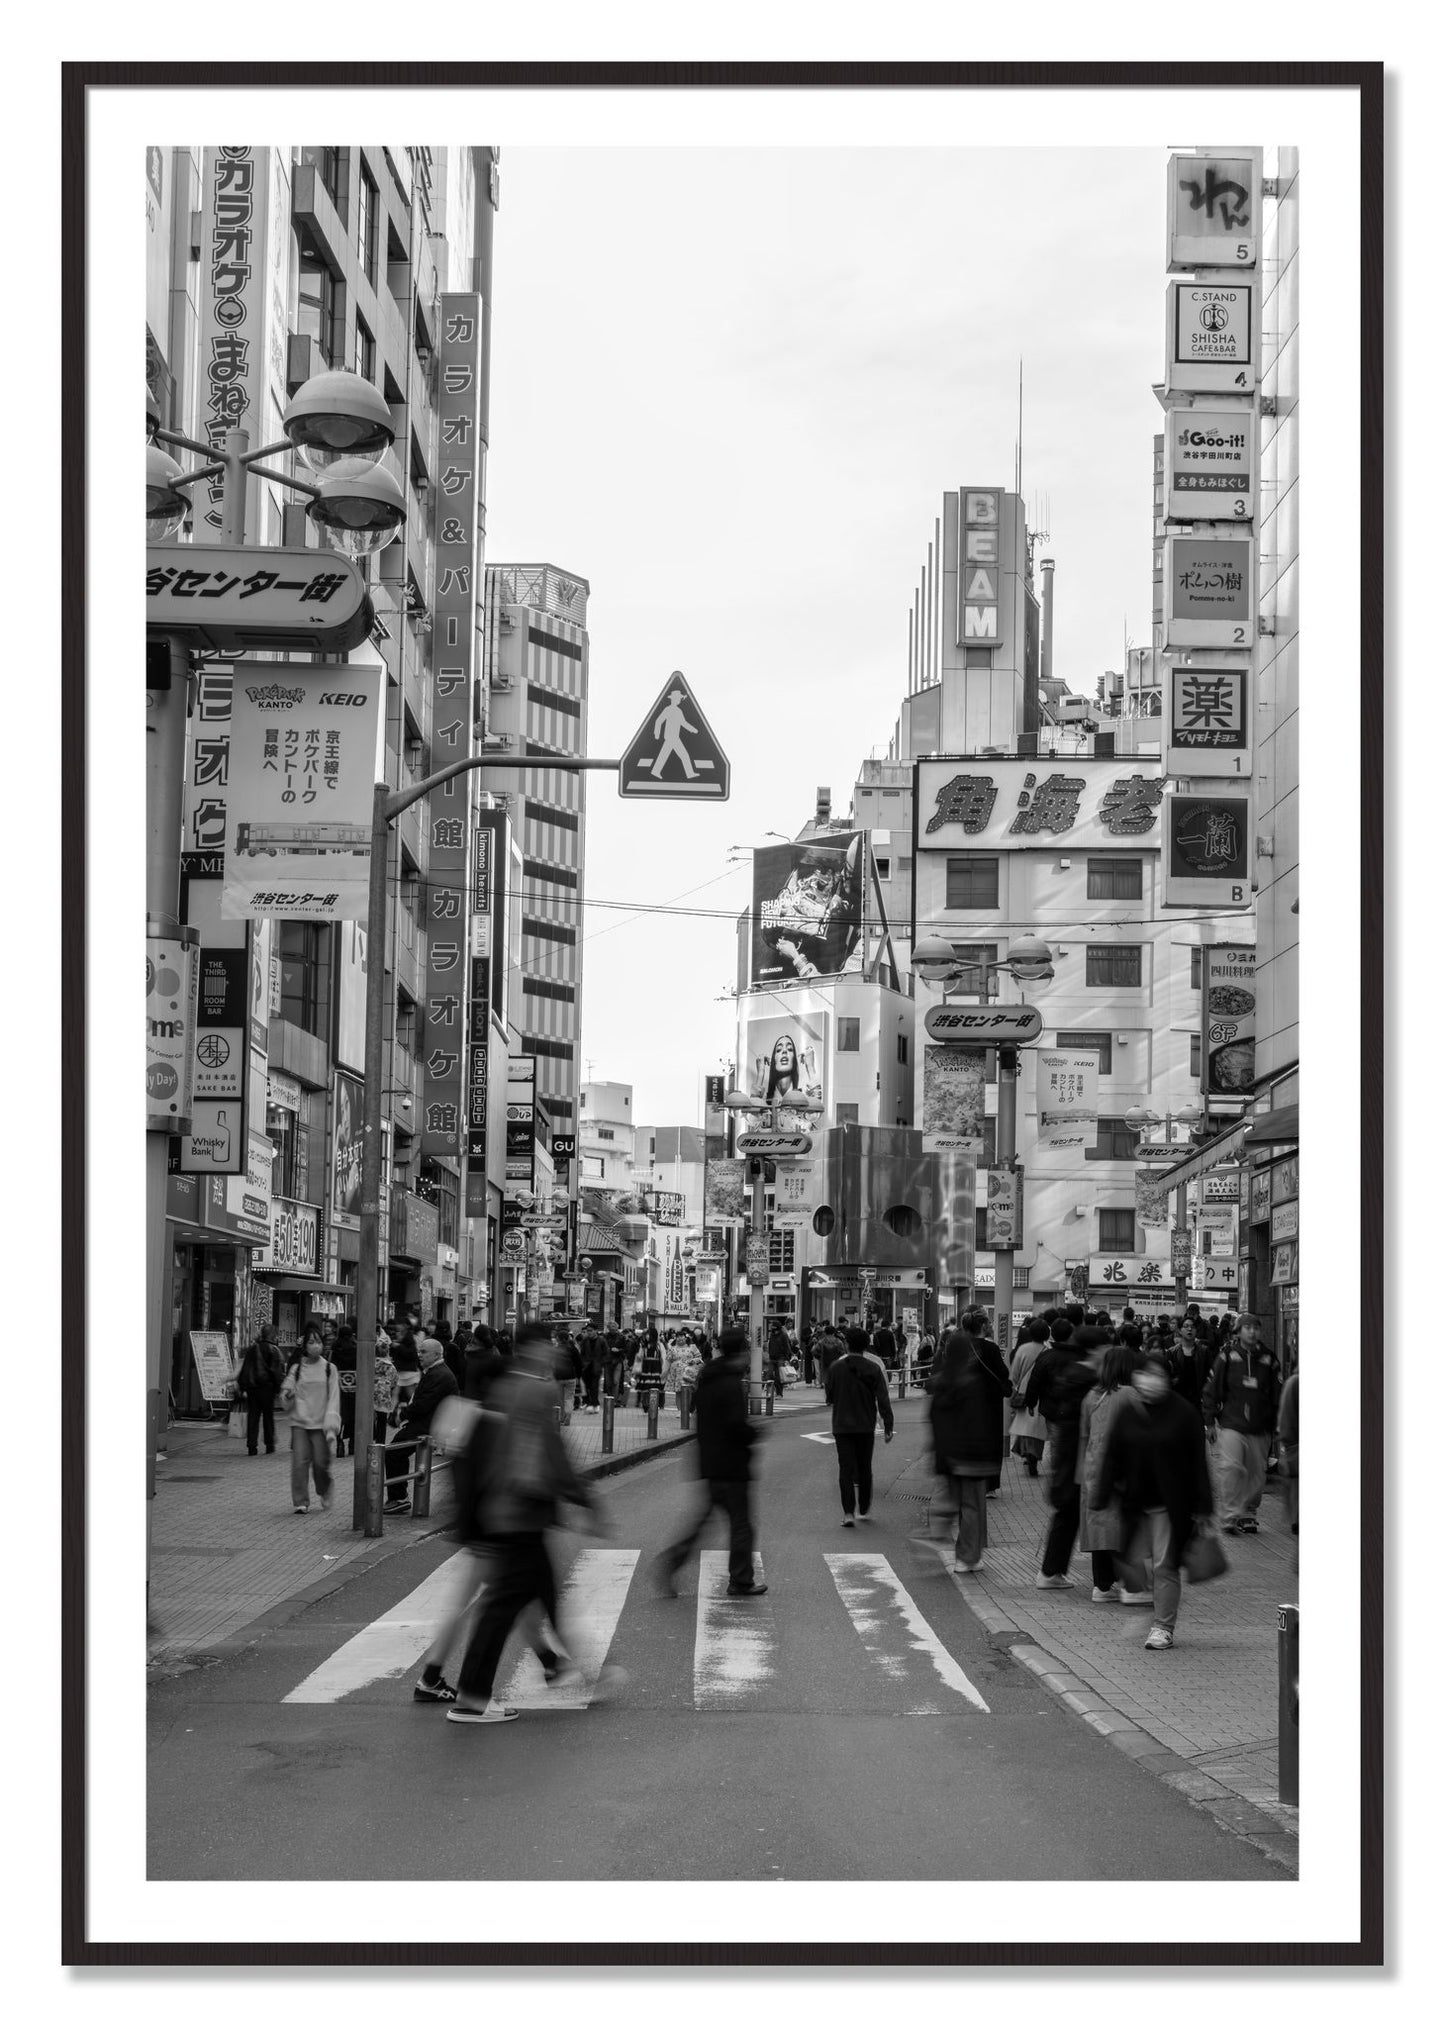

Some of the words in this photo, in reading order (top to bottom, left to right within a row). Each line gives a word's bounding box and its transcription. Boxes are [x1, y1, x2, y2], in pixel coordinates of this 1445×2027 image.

[212, 159, 254, 299] カラオケ
[1236, 244, 1249, 260] 5
[1191, 292, 1237, 302] C.STAND
[1191, 333, 1236, 344] SHISHA
[1191, 344, 1236, 353] CAFE&BAR
[1234, 371, 1247, 387] 4
[1190, 431, 1245, 447] Goo-it!
[1183, 451, 1241, 460] 渋谷宇田川町店
[1178, 476, 1246, 488] 全身もみほぐし
[1234, 499, 1246, 516] 3
[965, 493, 998, 638] BEAM
[1179, 571, 1244, 590] ポムの樹
[1233, 627, 1245, 643] 2
[258, 701, 293, 709] KANTO
[319, 693, 367, 707] KEIO
[1182, 676, 1233, 727] 薬
[1176, 731, 1238, 745] マツモトキヨシ
[262, 729, 279, 772] 冒険へ
[281, 729, 299, 803] カントーの
[302, 729, 320, 804] ポケパーク
[323, 730, 340, 790] 京王線で
[1232, 757, 1241, 772] 1
[925, 772, 1167, 835] 角海老
[1177, 813, 1238, 861] 一蘭
[479, 833, 488, 869] kimono
[250, 893, 339, 906] 渋谷センター街
[1232, 885, 1243, 902] B
[204, 968, 227, 976] THIRD
[427, 889, 460, 1133] カラオケ館
[932, 1014, 1036, 1028] 渋谷センター街
[1209, 1023, 1238, 1043] 6F
[156, 1072, 176, 1087] Day!
[192, 1138, 226, 1148] Whisky
[554, 1141, 574, 1152] GU
[741, 1138, 803, 1146] 渋谷センター街
[191, 1147, 211, 1156] Bank
[673, 1259, 682, 1302] BEER
